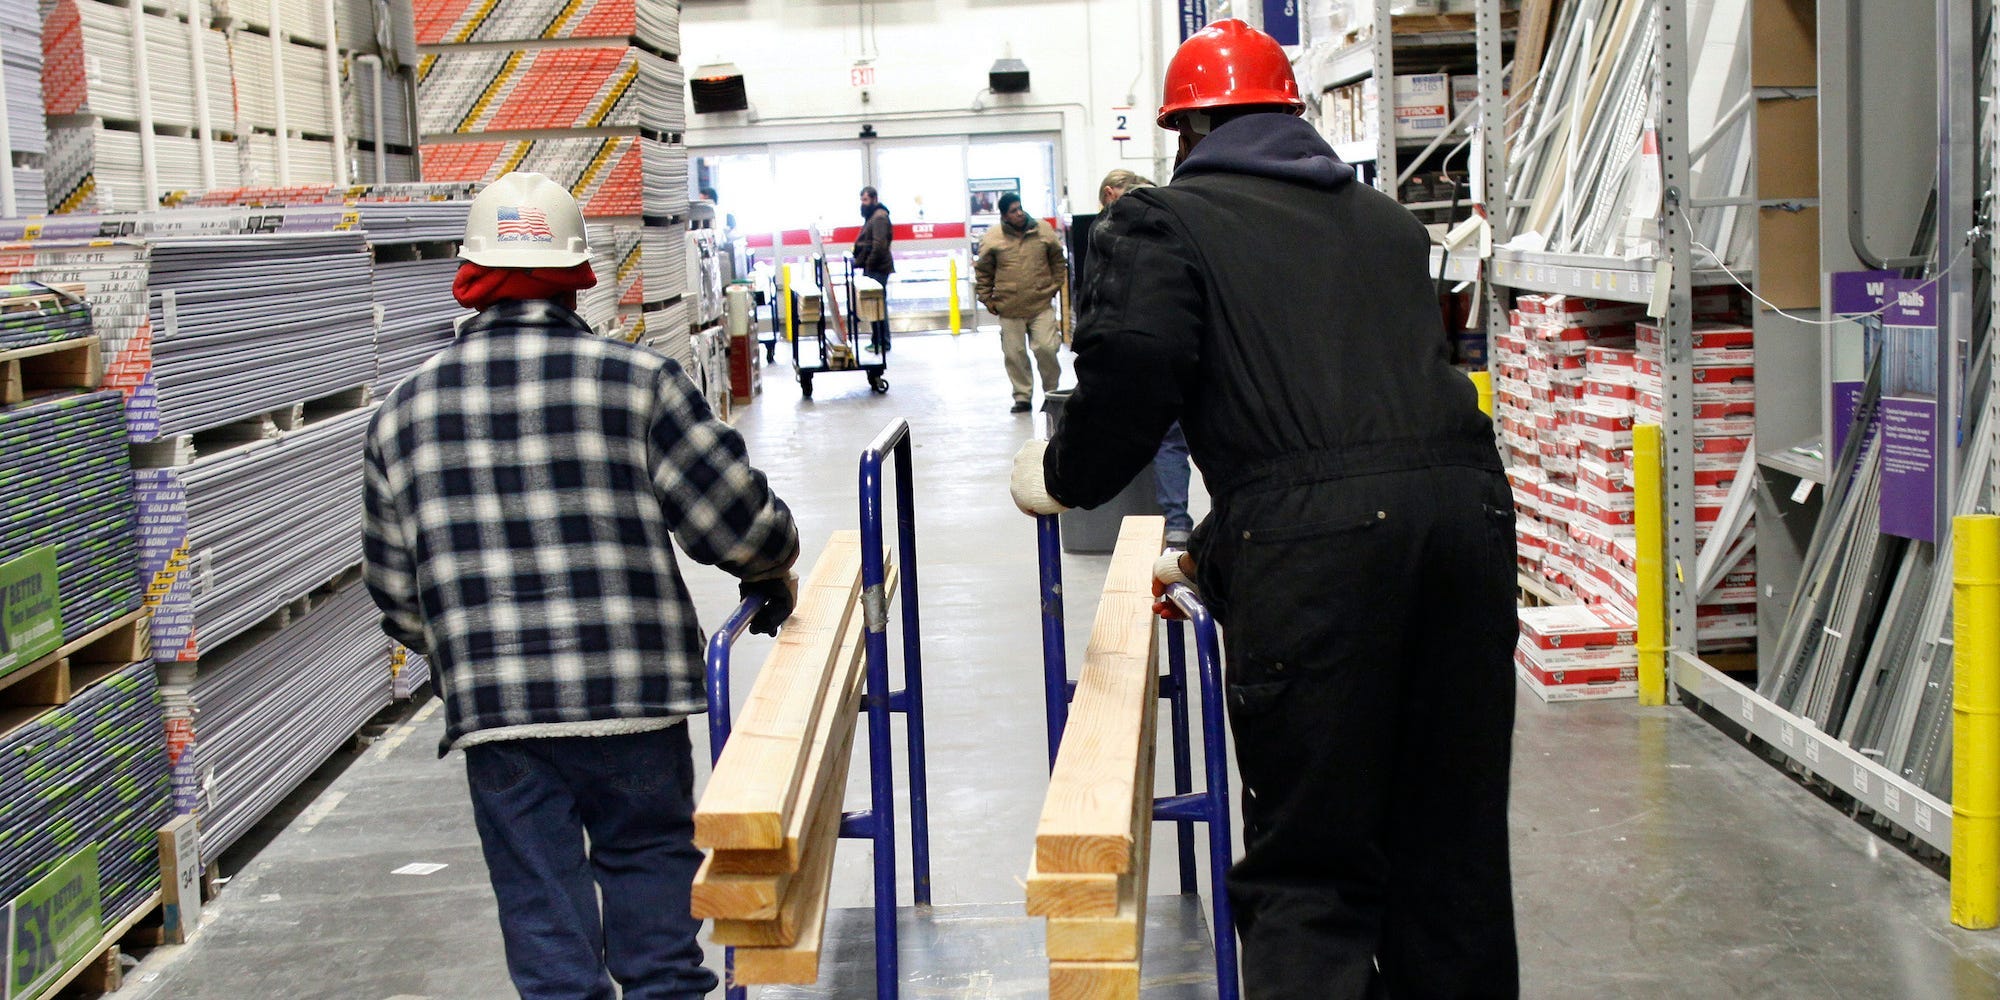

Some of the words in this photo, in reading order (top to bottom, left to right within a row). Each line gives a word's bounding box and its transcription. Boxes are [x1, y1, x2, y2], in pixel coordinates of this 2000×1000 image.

[851, 68, 875, 86] EXIT
[1117, 115, 1127, 130] 2
[912, 224, 934, 233] EXIT
[497, 233, 518, 242] United
[520, 233, 530, 242] We
[532, 234, 553, 243] Stand
[1898, 291, 1924, 307] Walls
[148, 503, 169, 513] GOLD
[160, 514, 182, 524] BOND
[152, 525, 174, 535] BOND
[146, 537, 168, 546] BOND
[9, 571, 43, 607] BETTER
